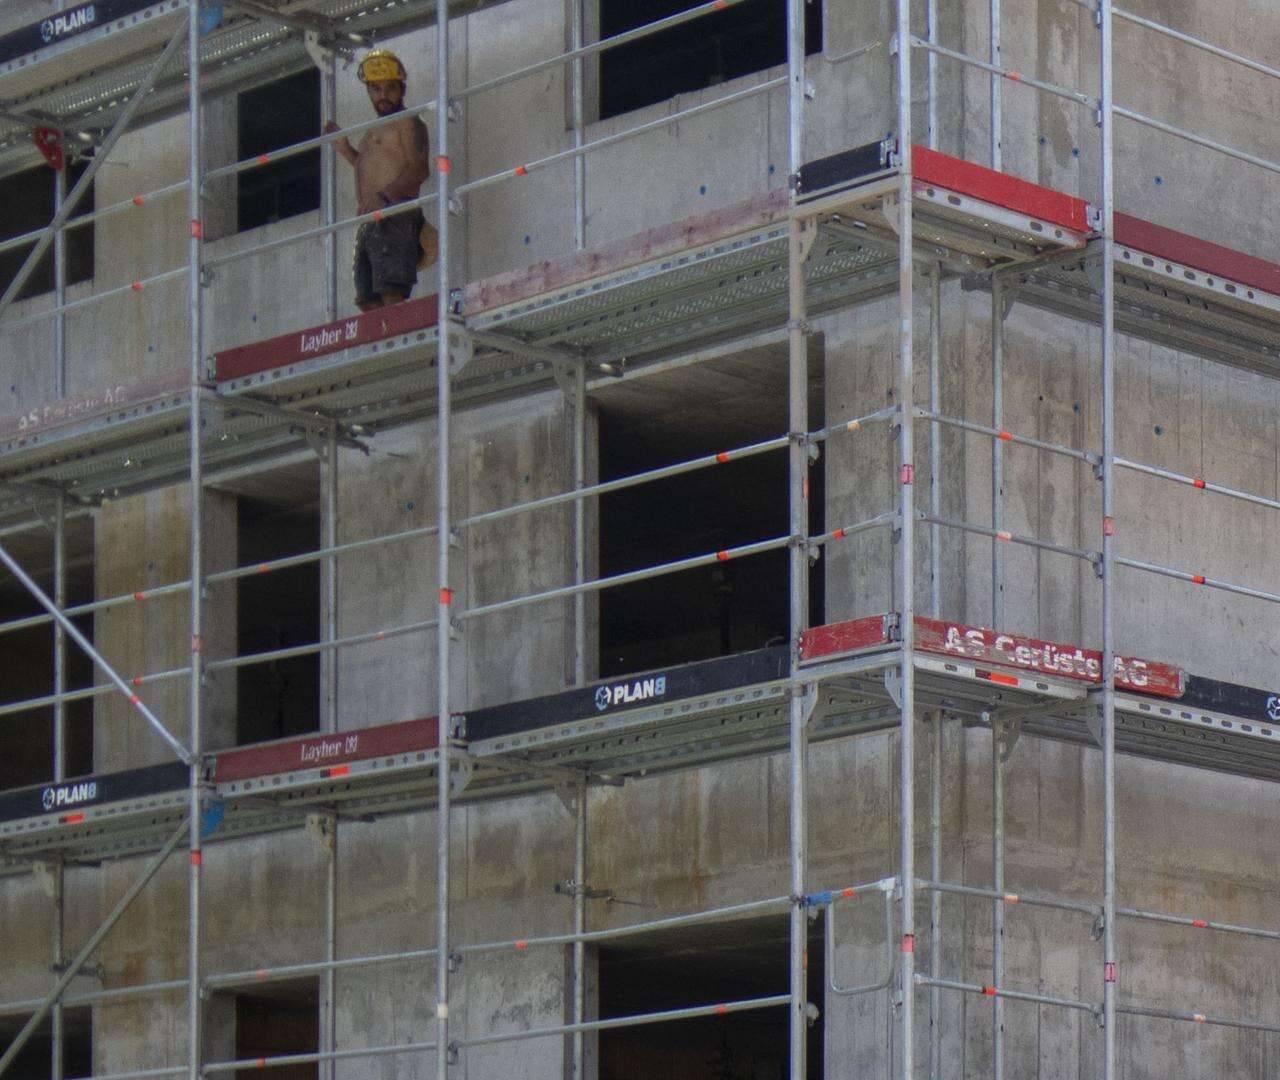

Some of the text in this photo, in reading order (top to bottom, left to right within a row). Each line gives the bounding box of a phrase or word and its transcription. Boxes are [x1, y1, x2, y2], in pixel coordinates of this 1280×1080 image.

[300, 328, 342, 353] Layher
[944, 627, 985, 656] AS
[614, 676, 666, 705] PLANB
[301, 740, 341, 762] Layher
